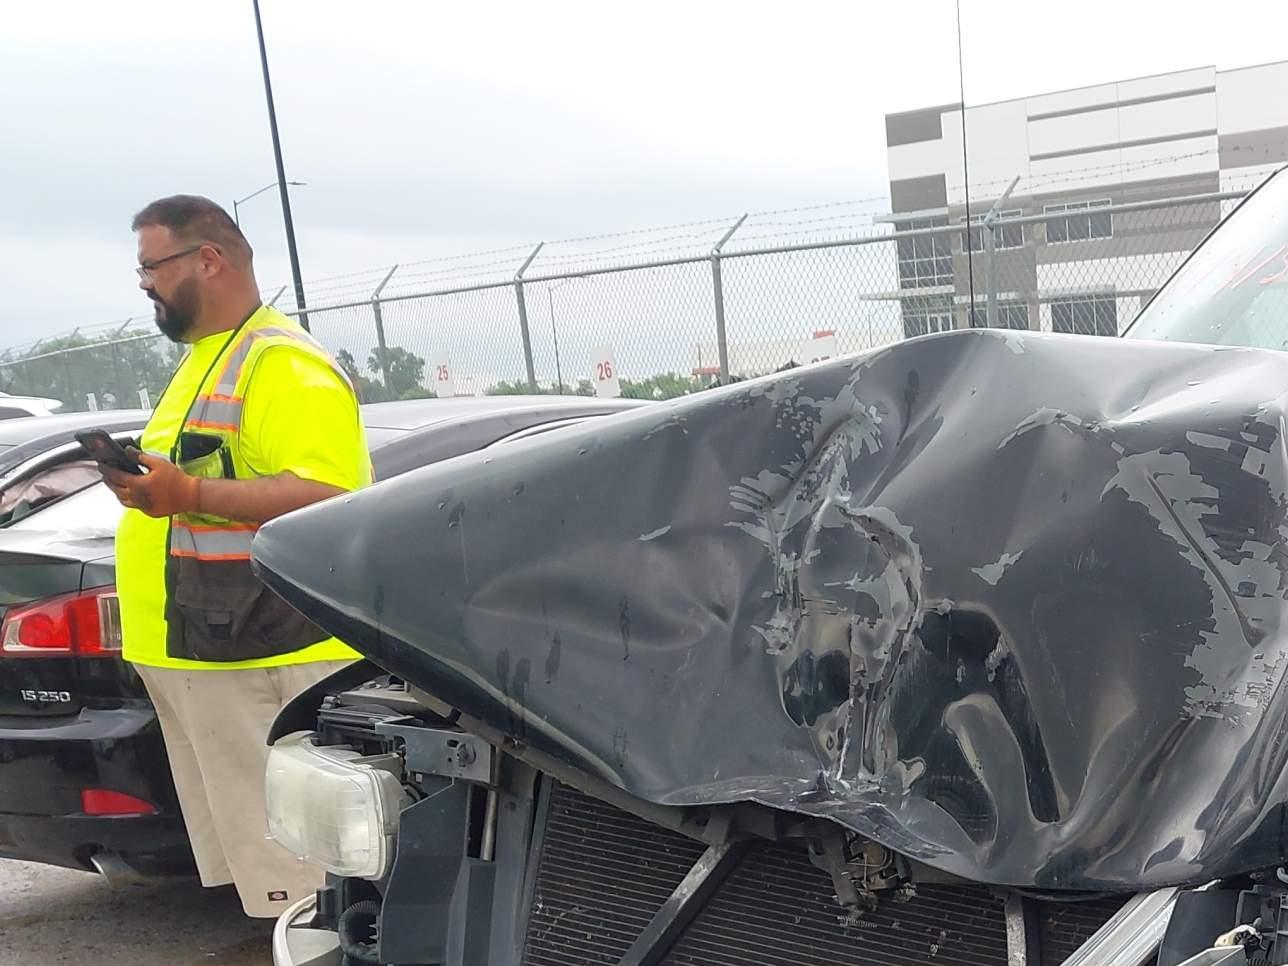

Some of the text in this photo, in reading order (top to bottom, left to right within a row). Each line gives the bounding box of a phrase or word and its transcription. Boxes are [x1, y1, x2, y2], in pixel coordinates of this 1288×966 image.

[436, 364, 449, 381] 25
[597, 360, 612, 381] 26
[20, 689, 72, 702] IS 250
